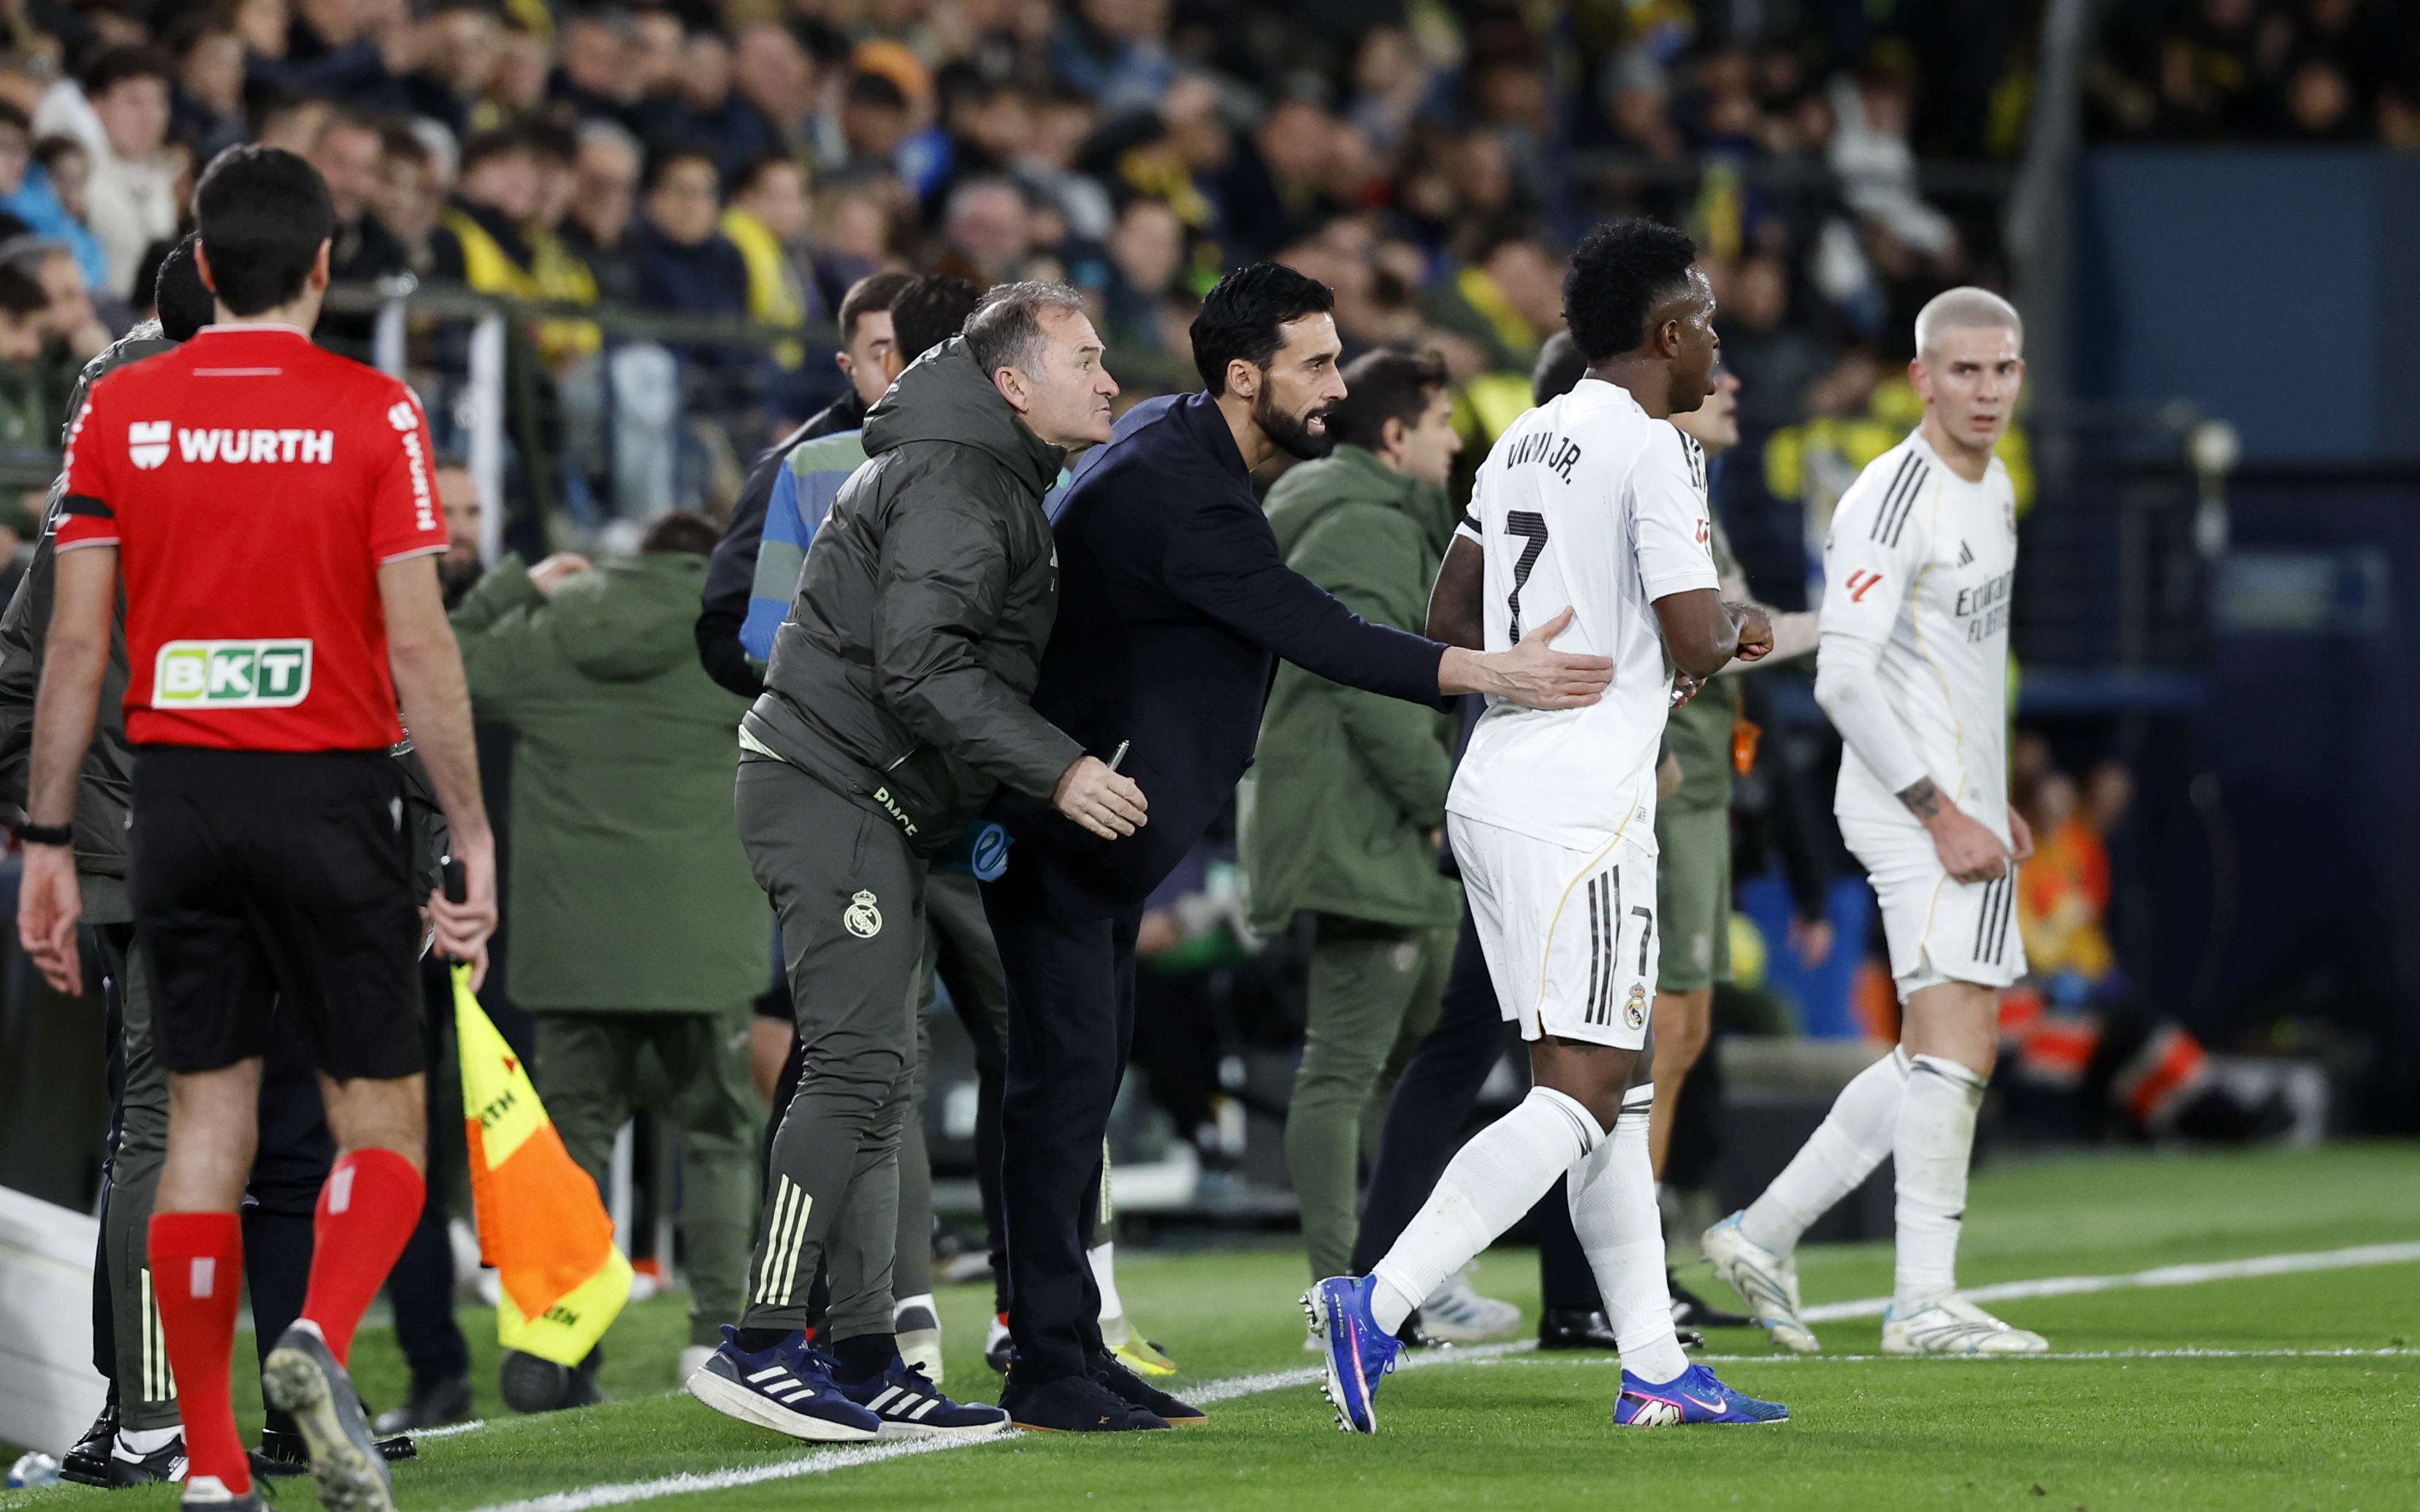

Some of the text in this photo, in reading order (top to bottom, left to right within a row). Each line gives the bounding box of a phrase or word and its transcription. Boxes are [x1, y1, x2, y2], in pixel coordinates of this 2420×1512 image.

[178, 428, 335, 464] WURTH
[1507, 432, 1581, 486] VINI JR.
[1504, 509, 1549, 645] 7
[164, 654, 303, 693] BKT
[1630, 905, 1652, 977] 7
